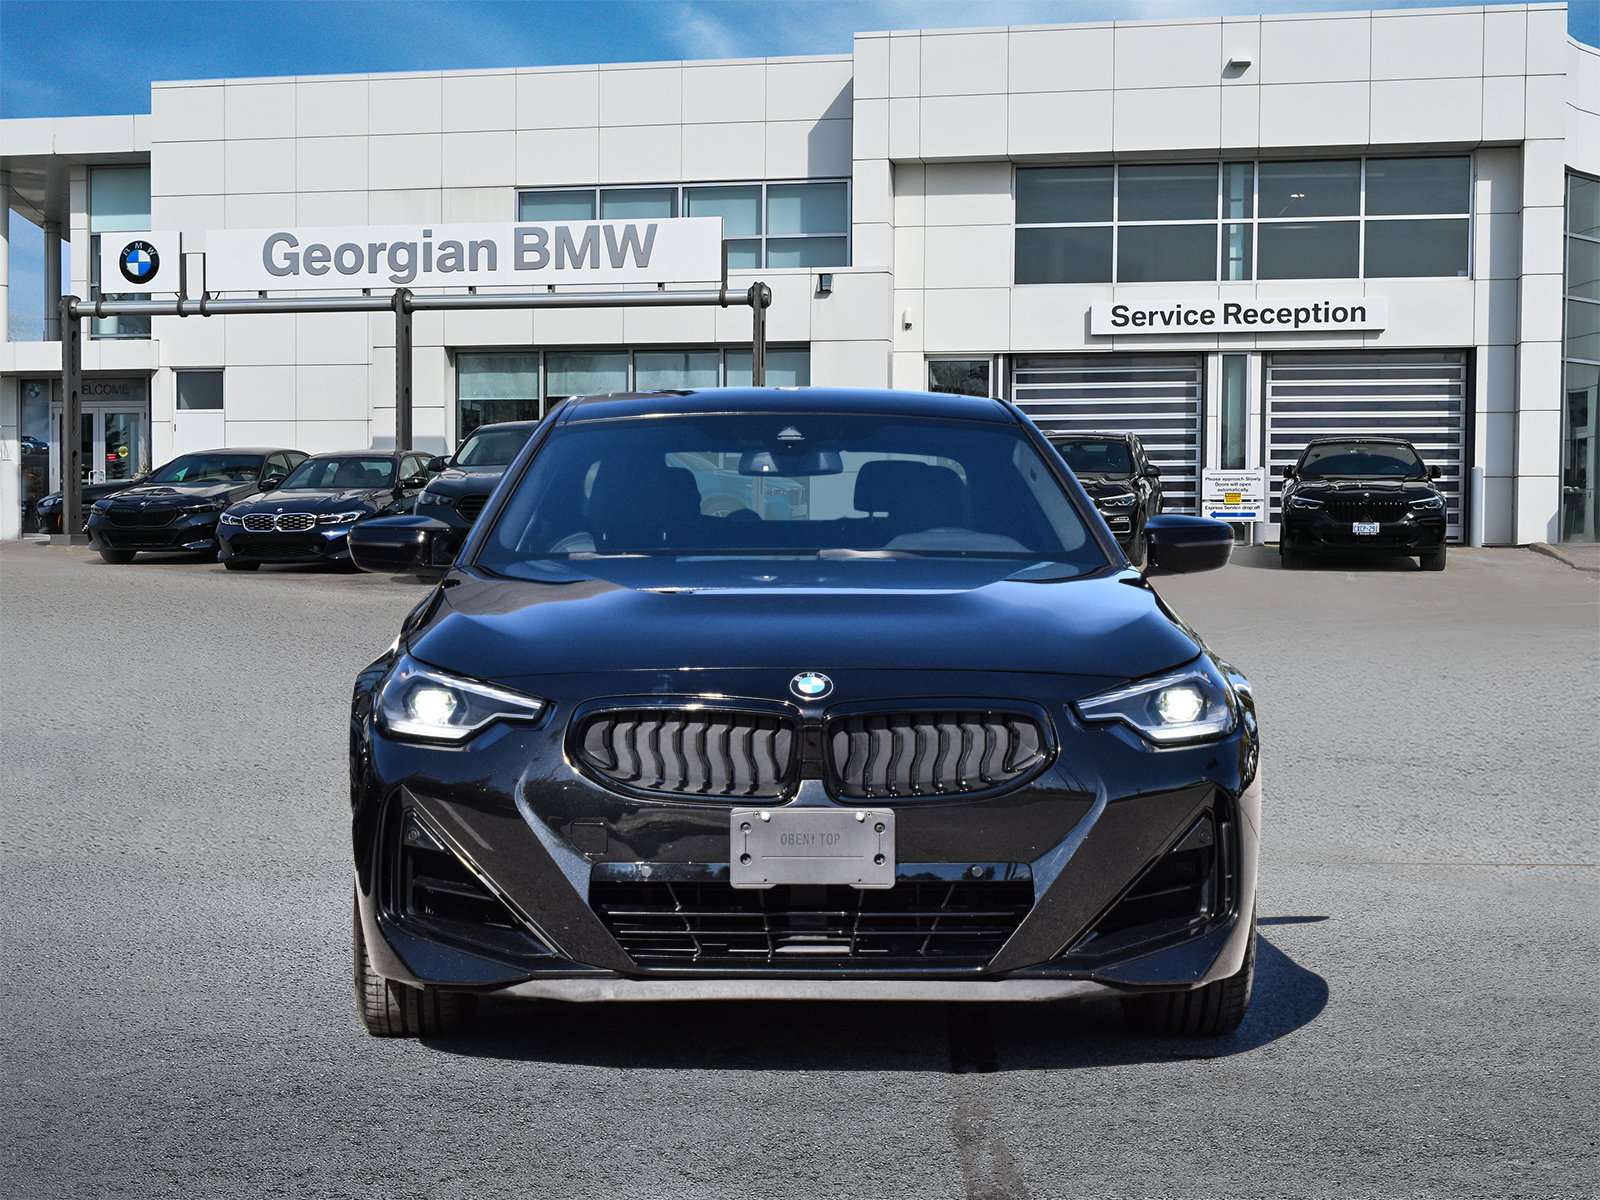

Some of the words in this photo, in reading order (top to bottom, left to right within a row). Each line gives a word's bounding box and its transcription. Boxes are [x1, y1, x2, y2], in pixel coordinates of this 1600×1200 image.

[123, 242, 157, 256] BMW
[262, 228, 498, 285] Georgian
[513, 223, 657, 271] BMW
[1111, 303, 1216, 327] Service
[1223, 301, 1367, 328] Reception
[81, 383, 129, 395] ELCOME
[819, 832, 841, 846] TOP
